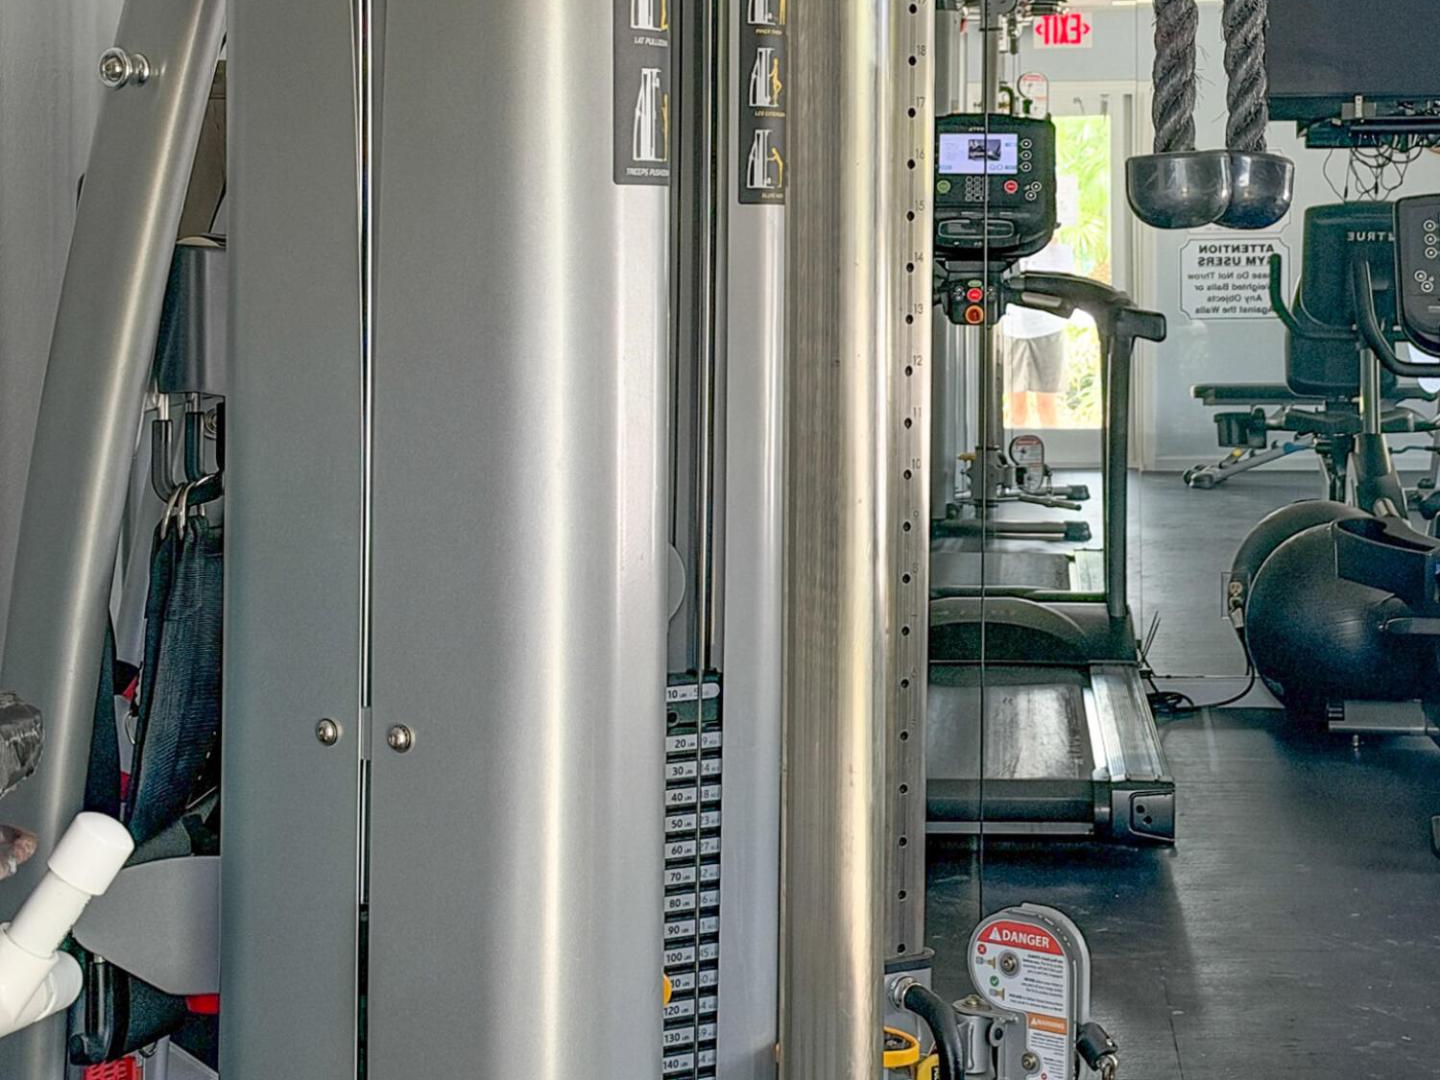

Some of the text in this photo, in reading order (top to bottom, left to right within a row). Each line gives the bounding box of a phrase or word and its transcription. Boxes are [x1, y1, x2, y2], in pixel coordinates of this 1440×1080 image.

[916, 45, 926, 57] 18
[916, 96, 926, 108] 17
[915, 148, 925, 160] 16
[915, 200, 925, 211] 15
[914, 252, 924, 263] 14
[914, 303, 924, 315] 13
[913, 355, 923, 367] 12
[913, 407, 922, 418] 11
[912, 458, 921, 470] 10
[667, 689, 678, 699] 10
[675, 739, 686, 749] 20
[672, 766, 684, 776] 30
[671, 792, 683, 802] 40
[672, 819, 683, 828] 50
[671, 845, 683, 855] 60
[670, 872, 682, 882] 70
[669, 899, 681, 908] 80
[668, 926, 680, 935] 90
[1002, 930, 1049, 948] DANGER
[666, 952, 683, 963] 100
[671, 979, 681, 988] 10
[664, 1005, 680, 1016] 120
[665, 1032, 680, 1043] 130
[663, 1059, 679, 1070] 140
